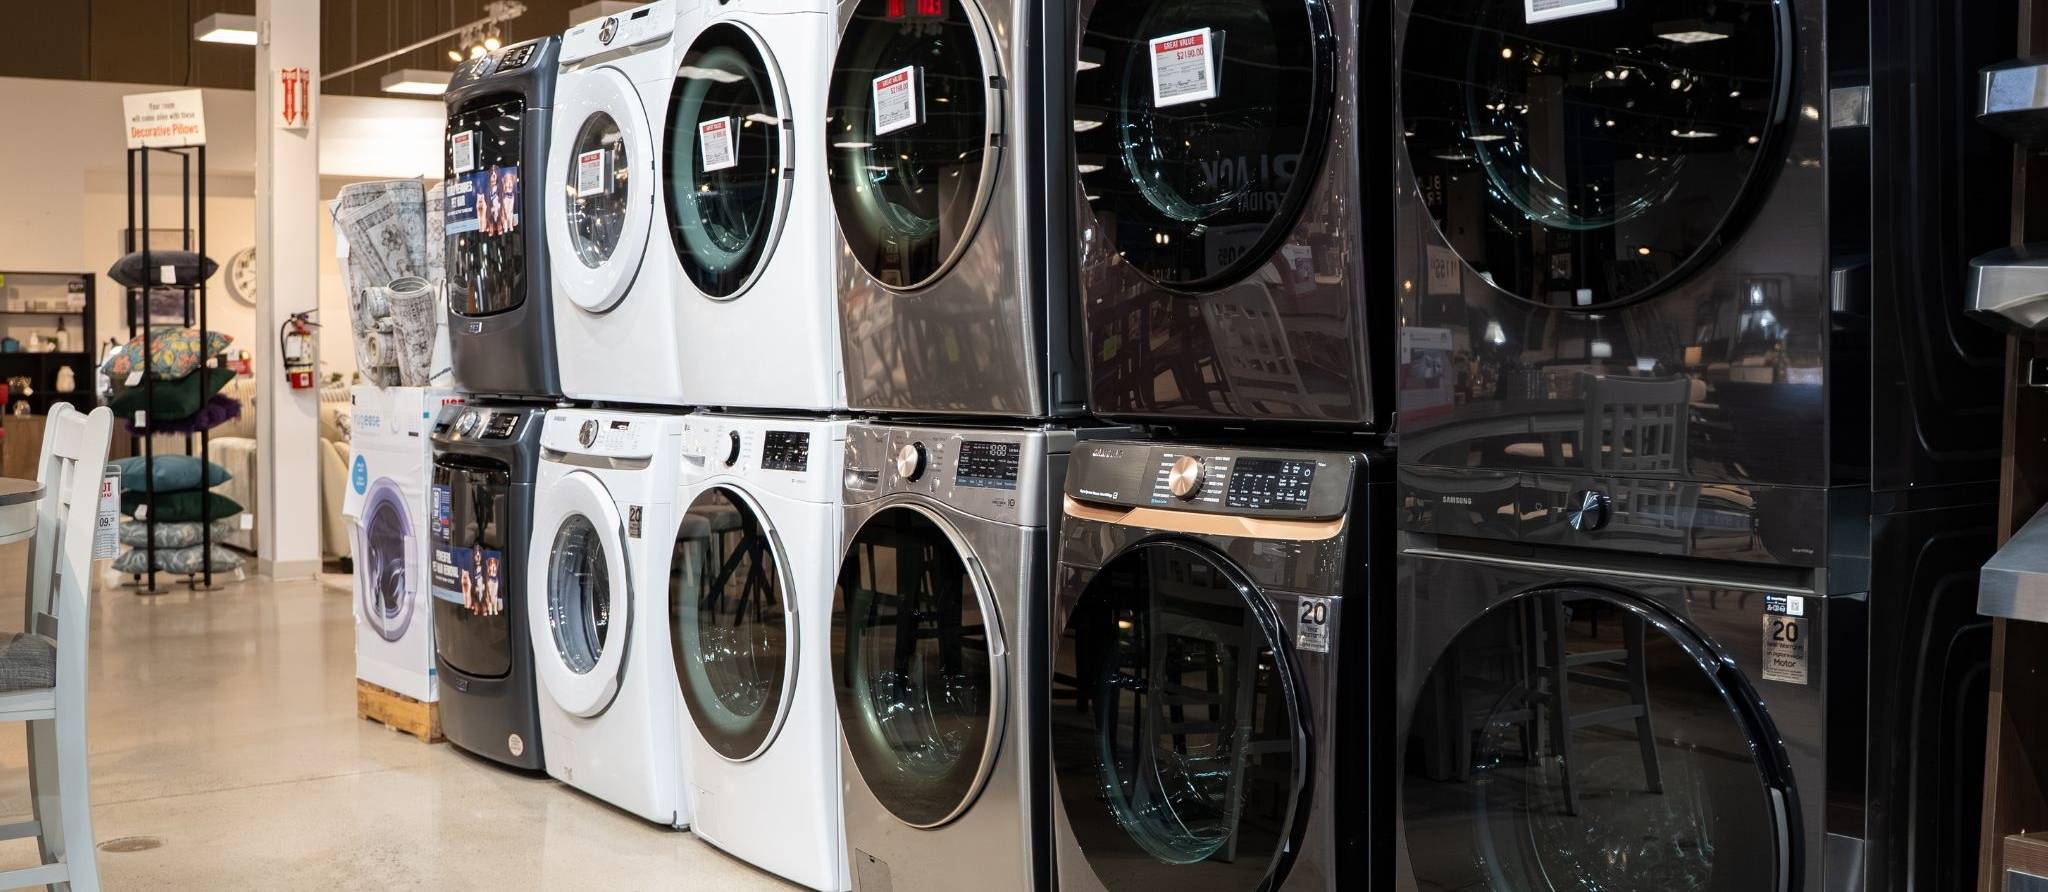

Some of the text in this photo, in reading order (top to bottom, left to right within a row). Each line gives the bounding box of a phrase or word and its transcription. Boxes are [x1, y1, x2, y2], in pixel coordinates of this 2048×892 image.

[1180, 37, 1195, 46] VALUE
[131, 123, 199, 138] Decorative Pillows
[1442, 495, 1472, 505] SAMSUNG
[1300, 600, 1327, 626] 20
[1772, 620, 1799, 643] 20
[1773, 658, 1797, 668] Motor
